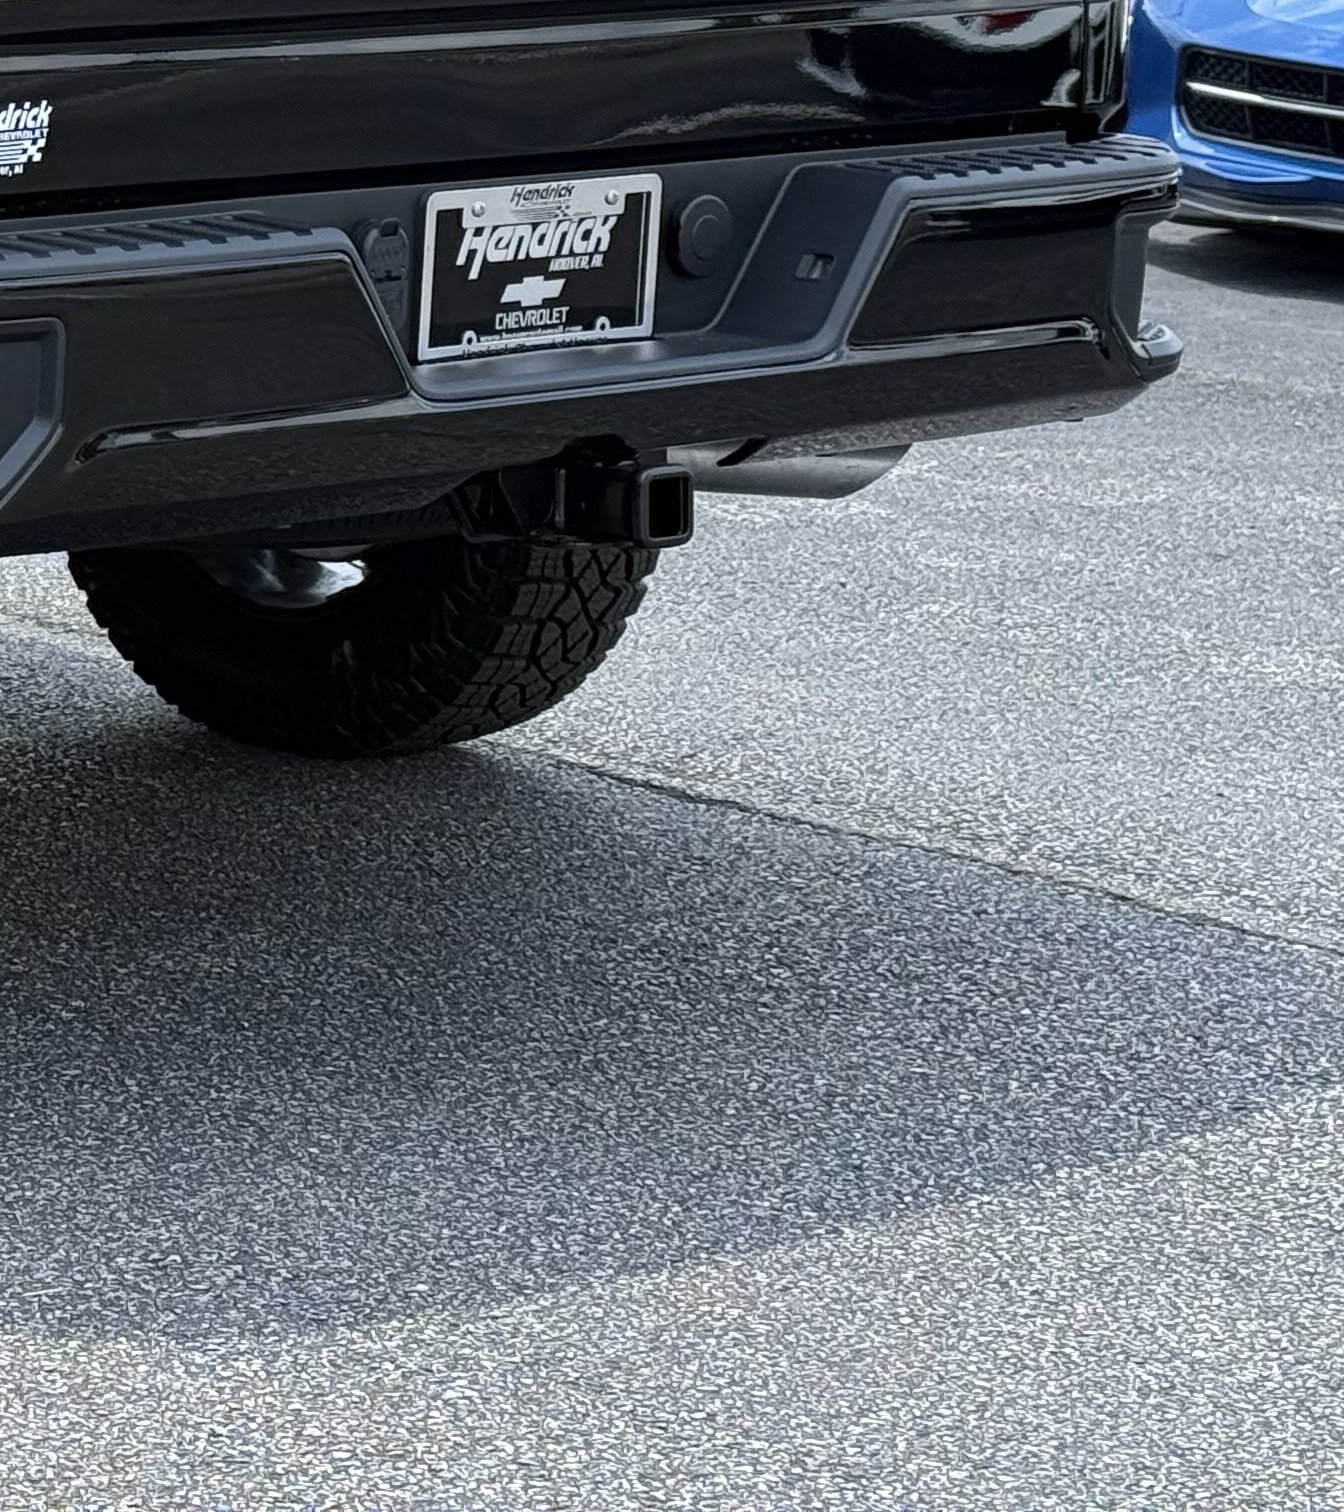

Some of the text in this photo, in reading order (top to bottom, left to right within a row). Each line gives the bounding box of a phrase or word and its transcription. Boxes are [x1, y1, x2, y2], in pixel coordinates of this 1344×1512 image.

[509, 183, 575, 208] Hendrick
[455, 216, 618, 280] Hendrick
[495, 306, 570, 330] CHEVROLET
